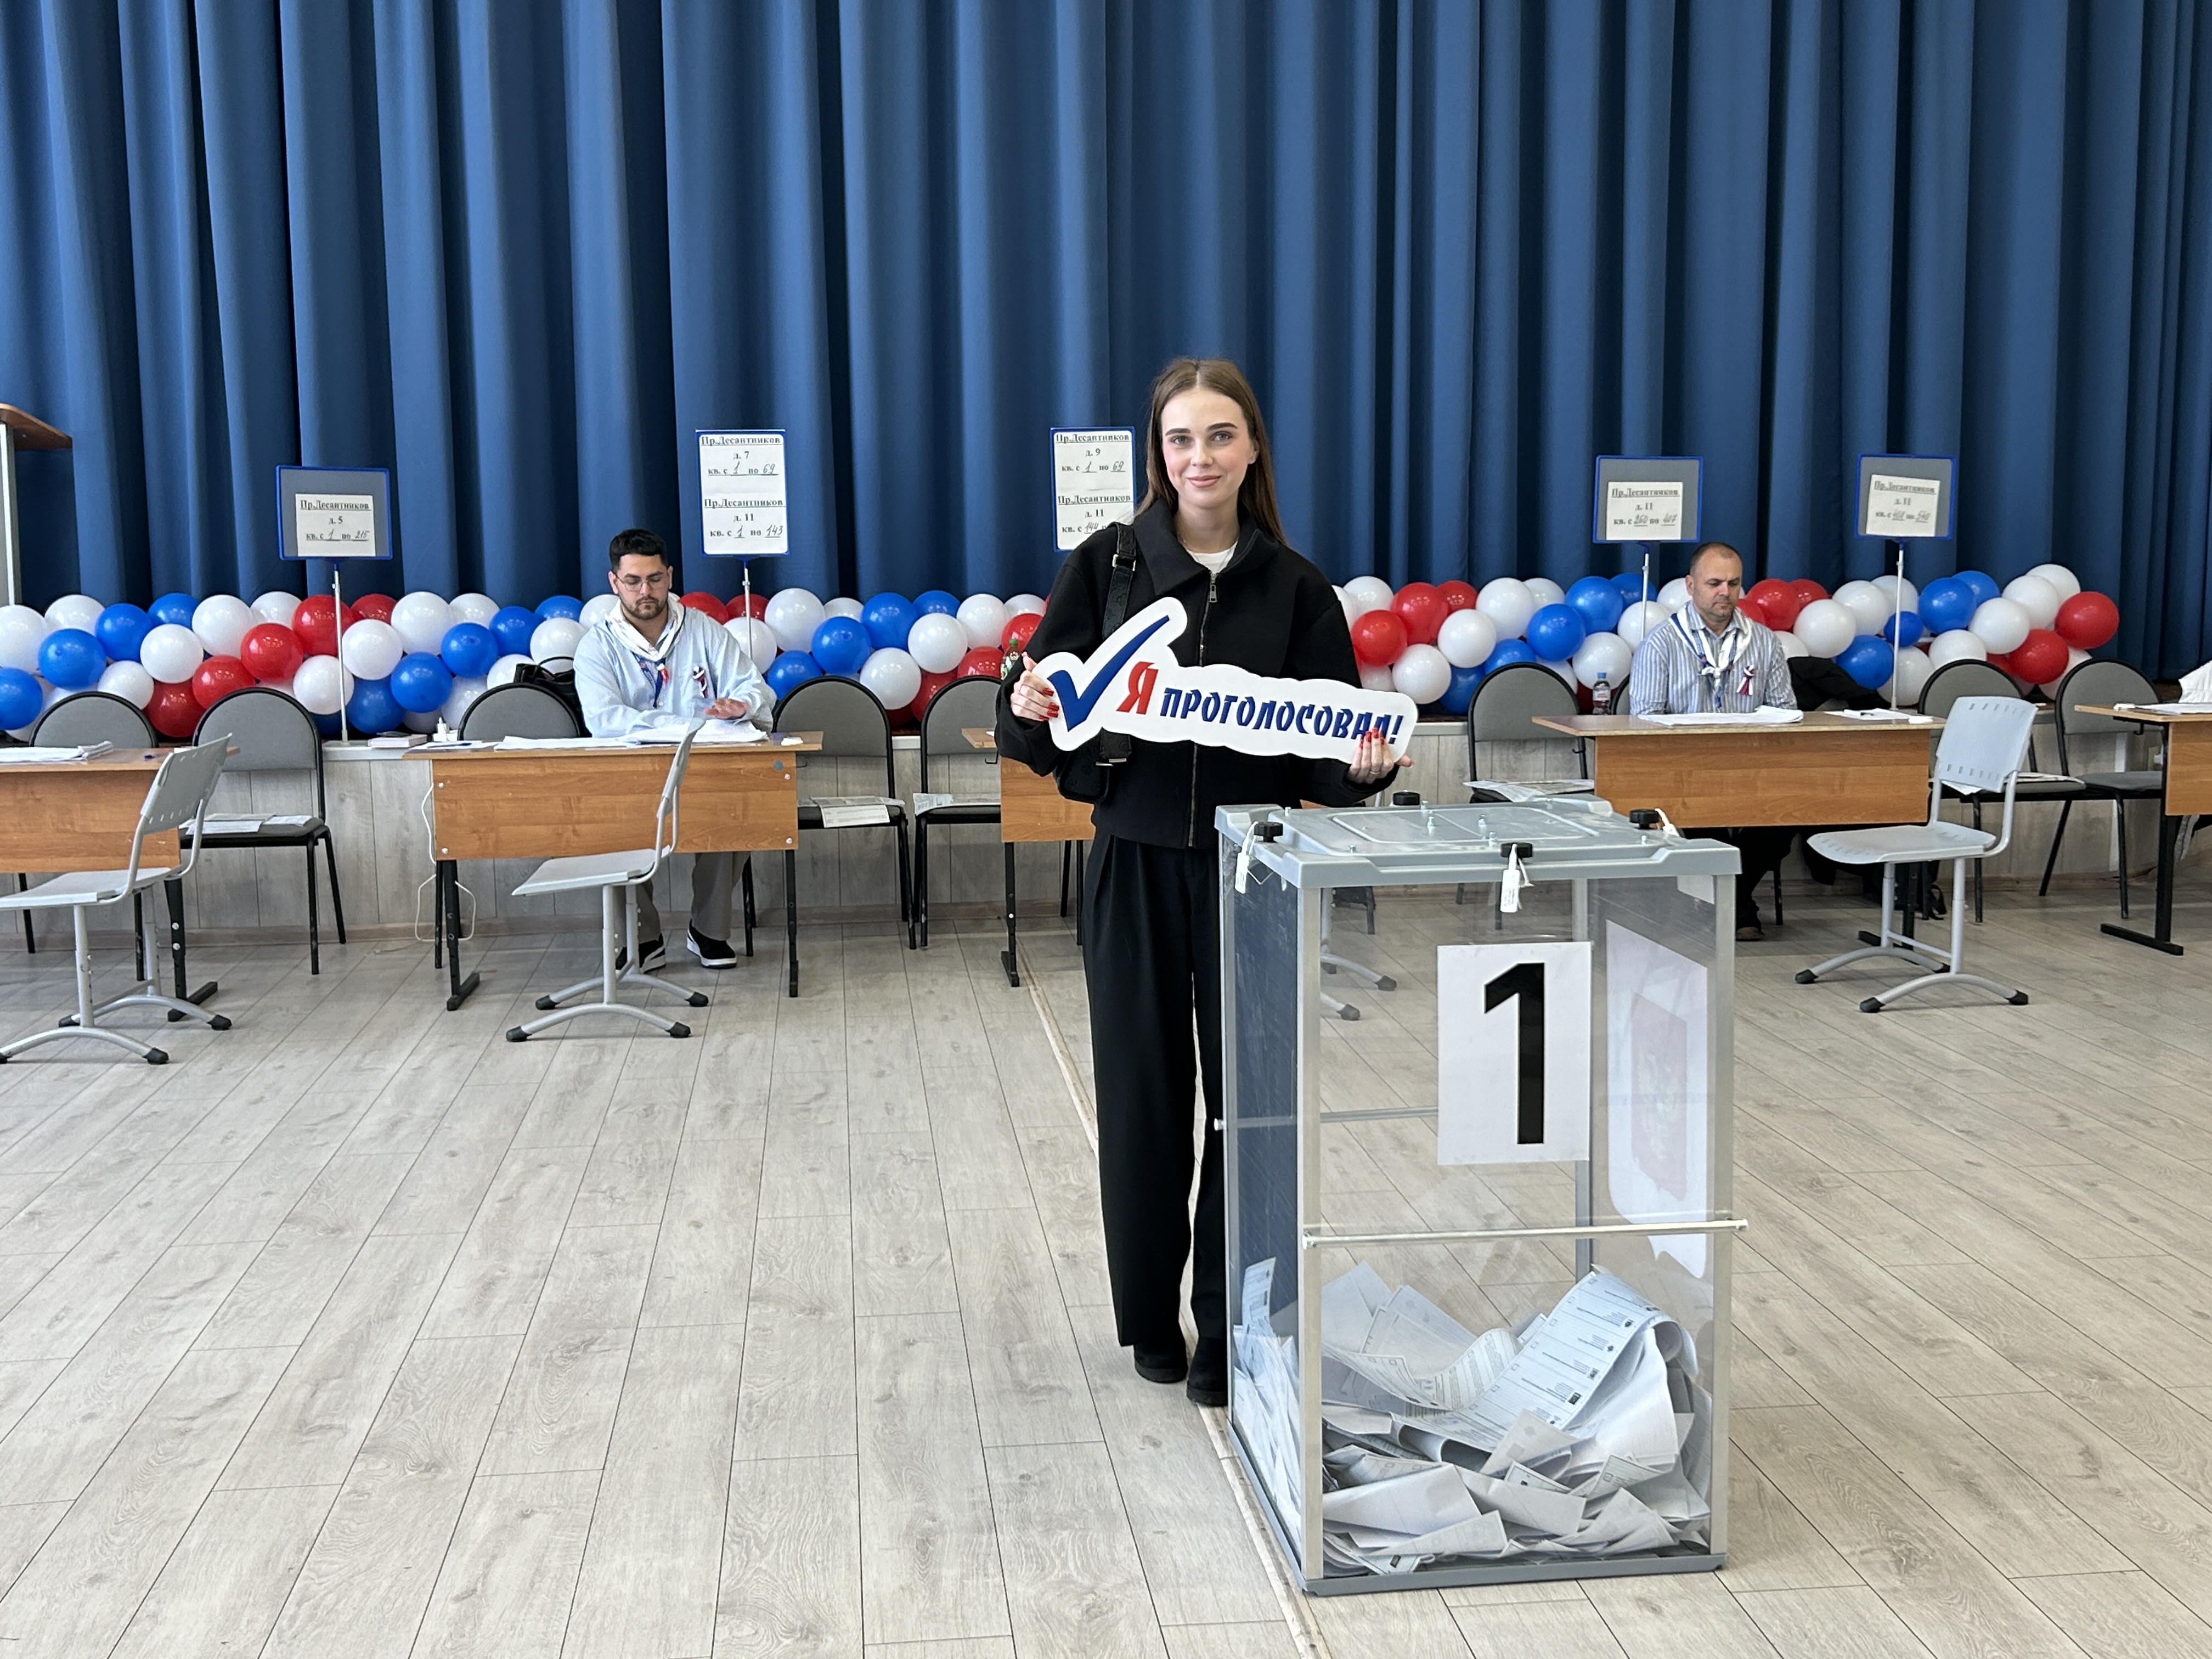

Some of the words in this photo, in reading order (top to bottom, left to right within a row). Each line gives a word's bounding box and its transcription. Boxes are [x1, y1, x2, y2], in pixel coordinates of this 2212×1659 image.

[701, 436, 781, 447] Пр.Десантников
[744, 451, 750, 459] 7
[733, 461, 740, 475] 1
[763, 464, 775, 474] 69
[1085, 461, 1092, 472] 1
[1112, 460, 1124, 471] 69
[300, 500, 369, 510] Пр.Десантников
[704, 499, 783, 509] Пр.Десантников
[1903, 498, 1911, 506] 11
[1096, 509, 1104, 517] 11
[338, 516, 343, 524] 5
[328, 528, 334, 540] 1
[354, 531, 370, 539] 215
[737, 525, 743, 538] 1
[766, 524, 783, 538] 143
[1116, 661, 1159, 715] Я
[1160, 687, 1404, 744] ПРОГОЛОСОВАЛ!
[1484, 962, 1545, 1145] 1
